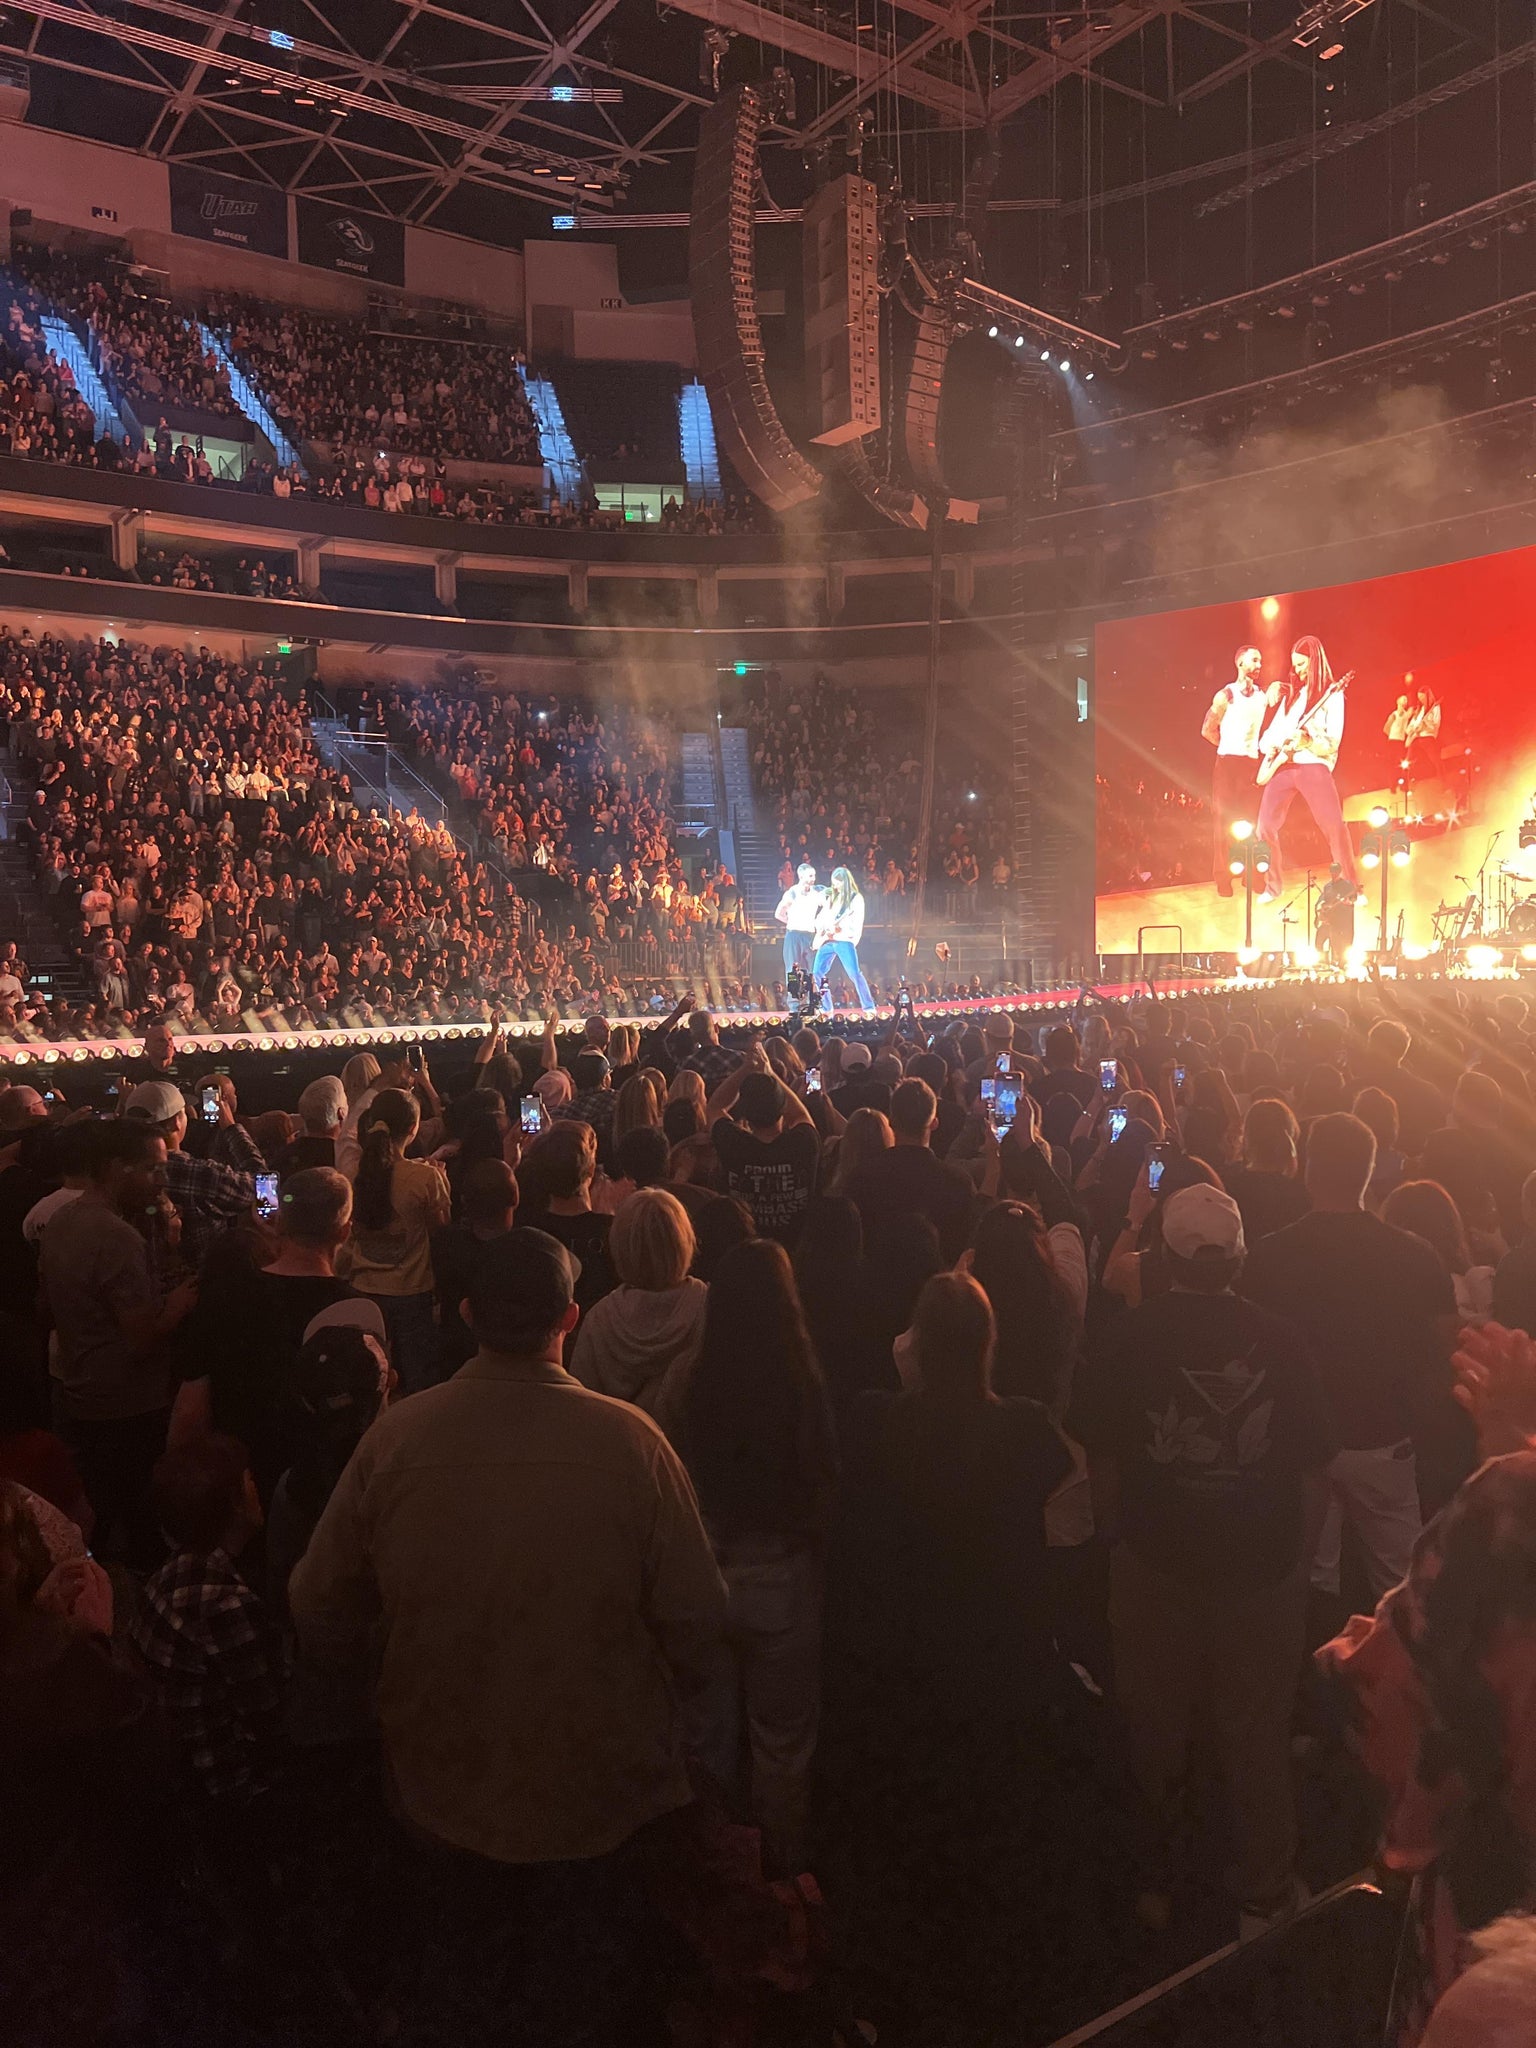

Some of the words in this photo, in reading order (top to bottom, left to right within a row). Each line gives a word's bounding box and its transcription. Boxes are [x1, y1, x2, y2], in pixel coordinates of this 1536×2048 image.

[200, 193, 258, 220] UTAH
[603, 298, 619, 309] KK
[728, 1168, 808, 1193] FTHE
